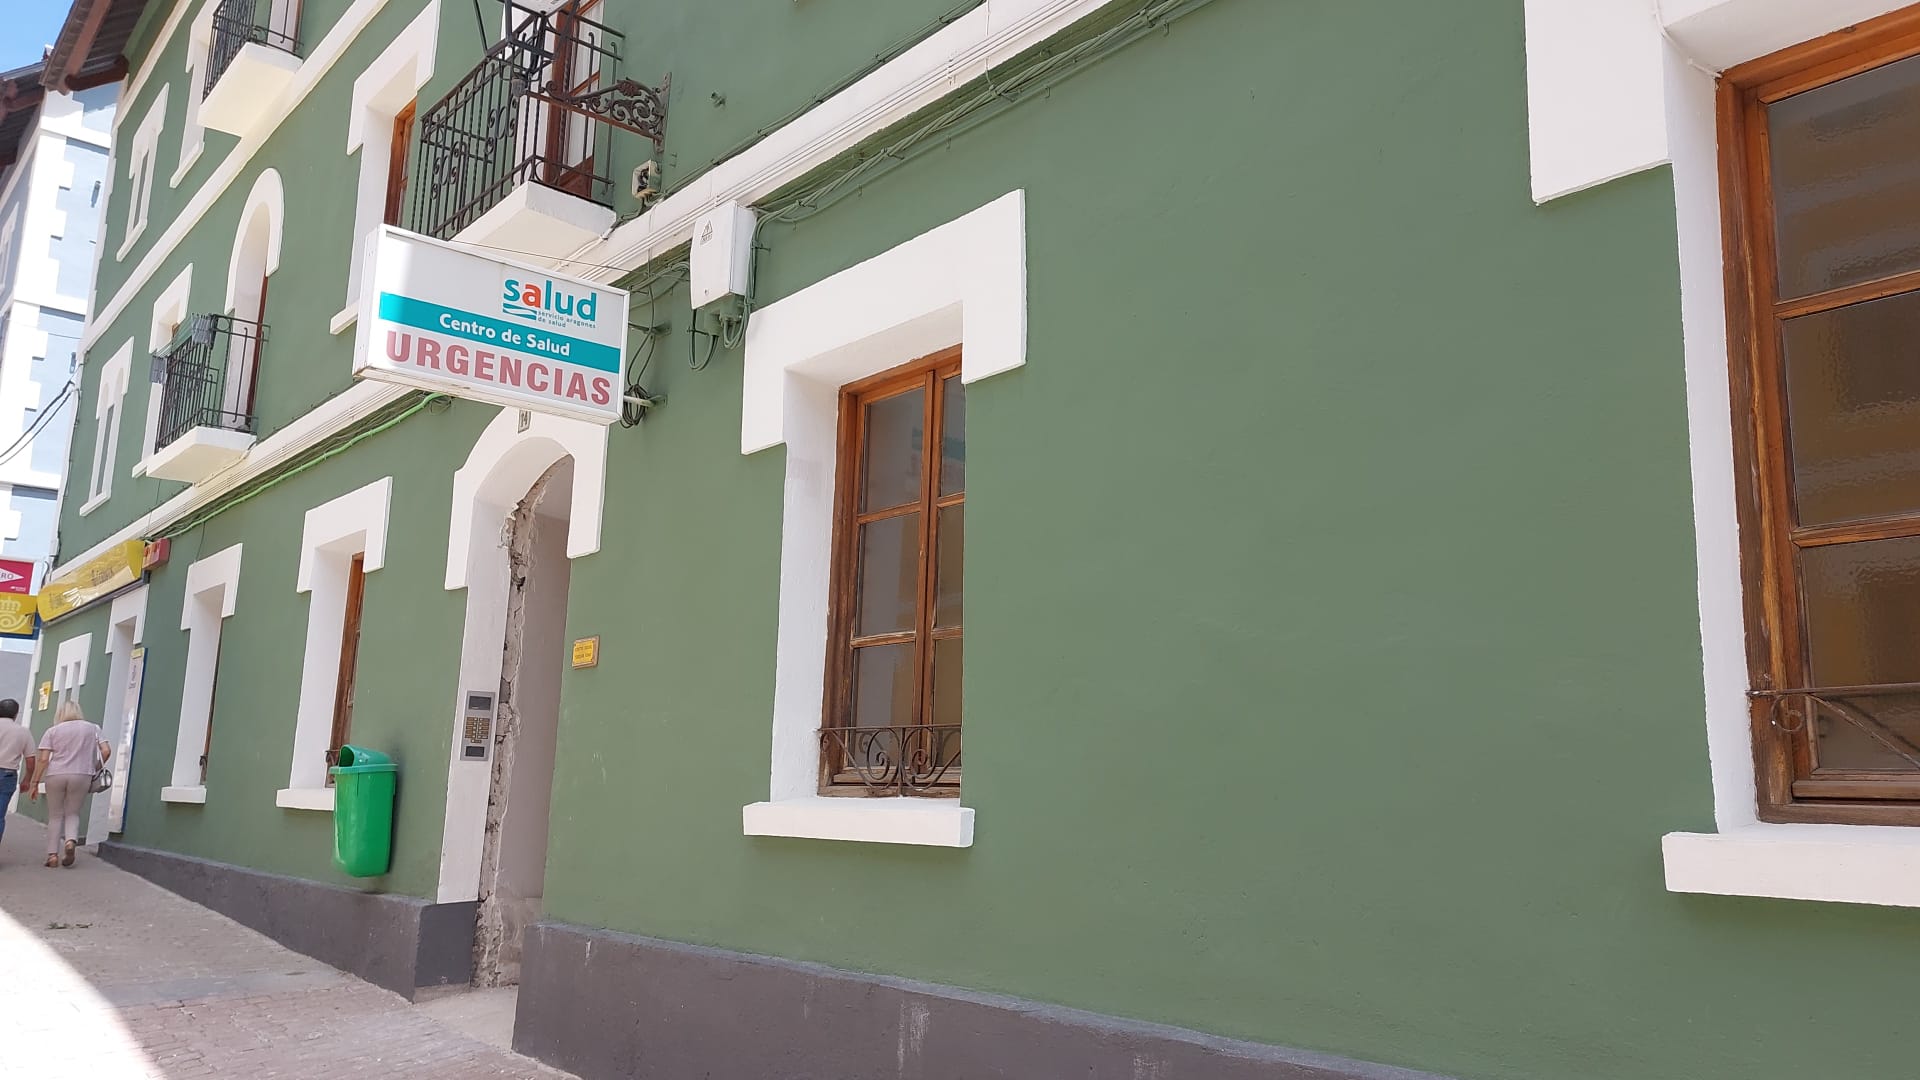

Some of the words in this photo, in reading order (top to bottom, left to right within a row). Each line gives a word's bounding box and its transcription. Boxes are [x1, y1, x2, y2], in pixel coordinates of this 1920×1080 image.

[503, 279, 597, 321] salud
[538, 311, 564, 321] servicio
[439, 313, 496, 339] Centro
[501, 328, 522, 345] de
[526, 333, 571, 356] Salud
[548, 318, 567, 328] salud
[386, 330, 611, 405] URGENCIAS
